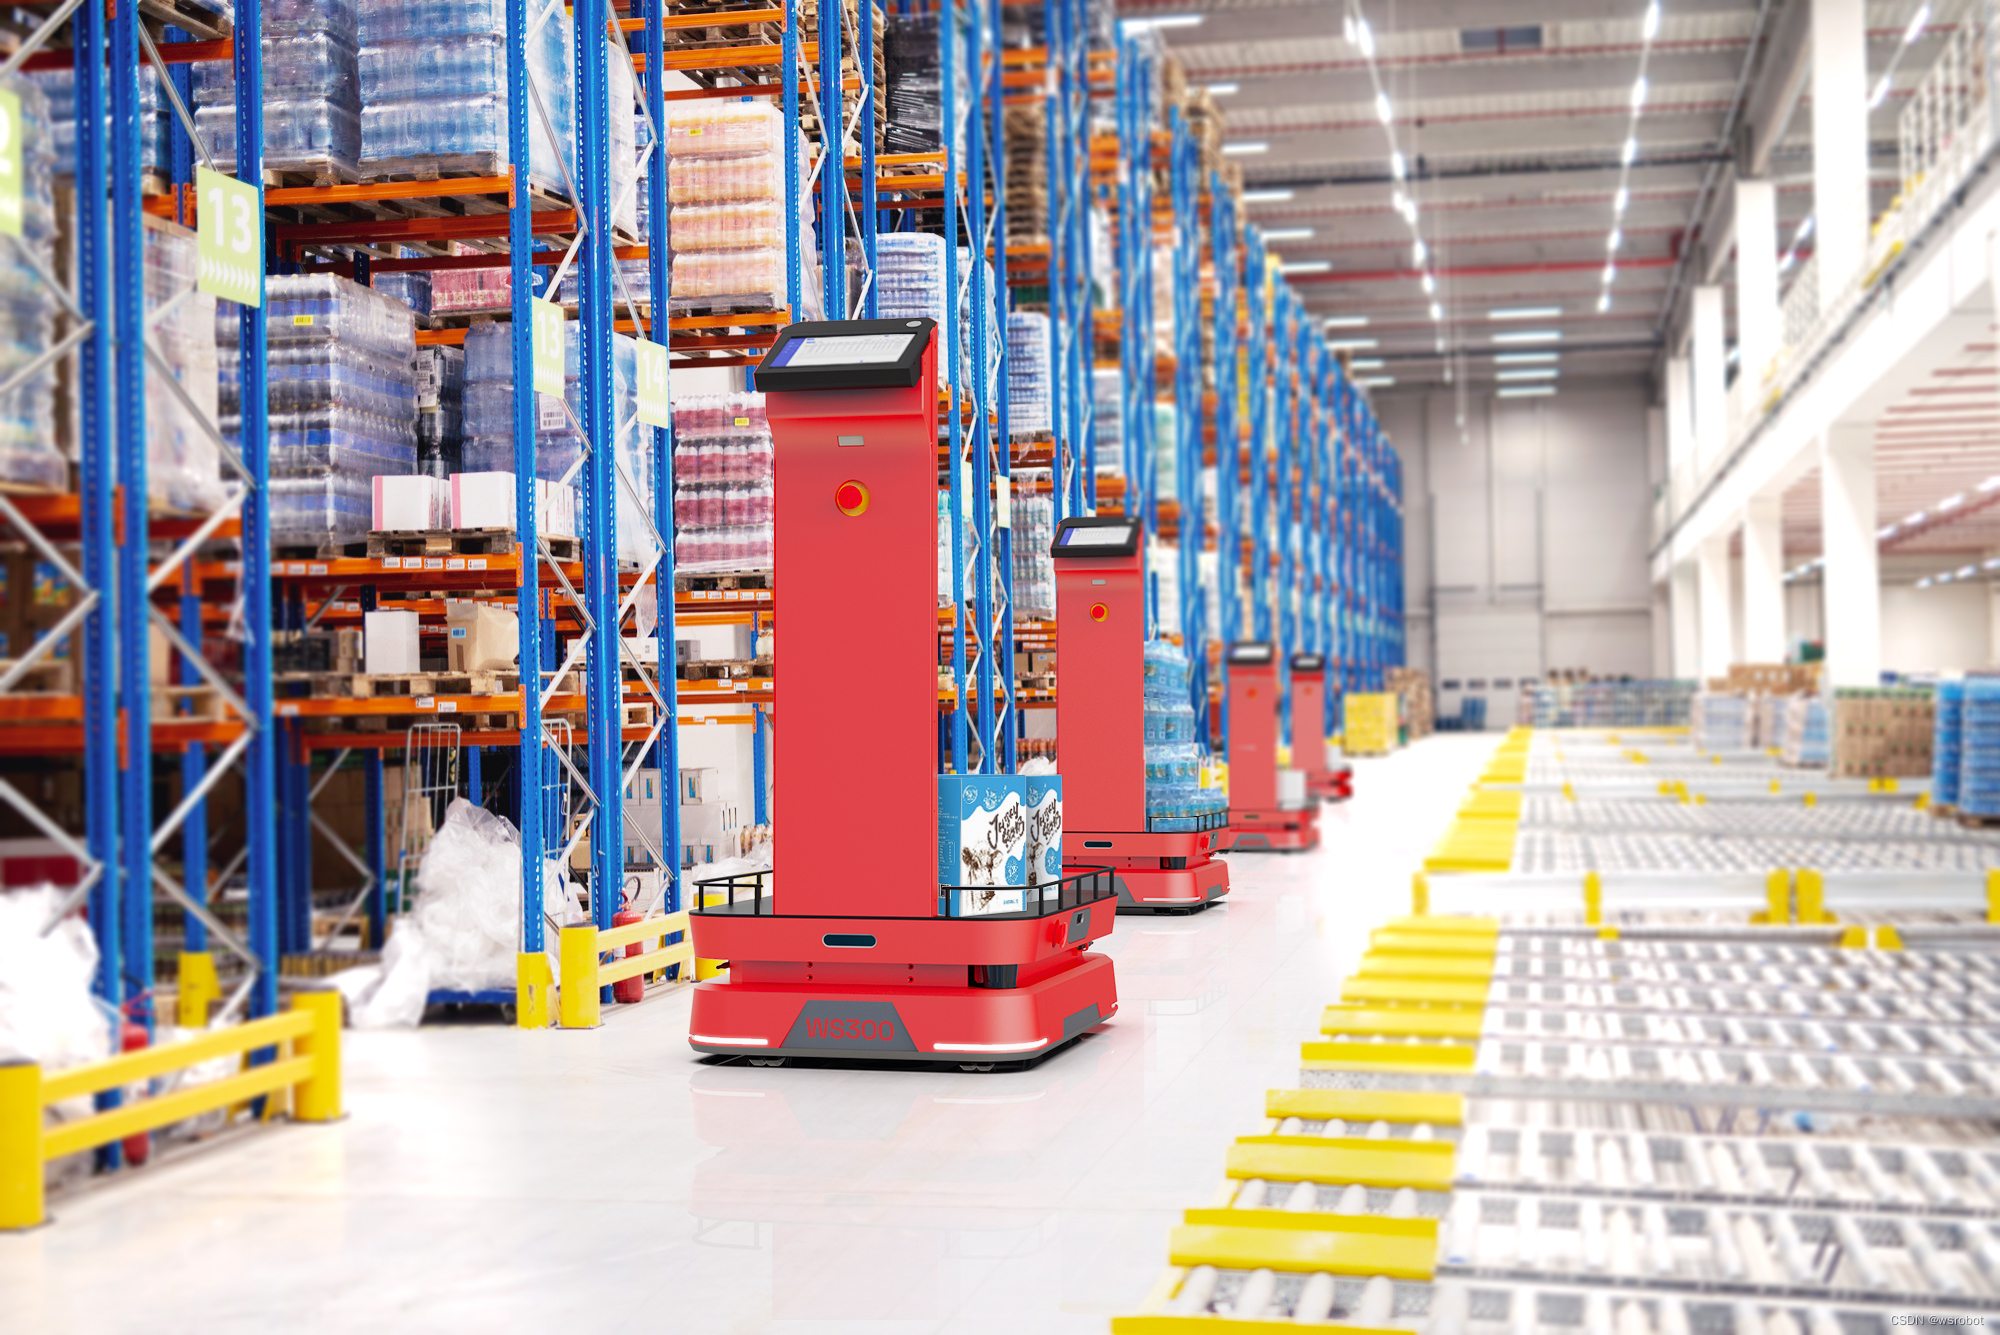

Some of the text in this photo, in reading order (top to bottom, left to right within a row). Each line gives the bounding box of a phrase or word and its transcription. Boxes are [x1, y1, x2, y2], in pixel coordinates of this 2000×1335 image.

[208, 187, 252, 254] 13
[537, 310, 560, 359] 13
[642, 350, 665, 393] 14
[806, 1018, 894, 1041] WS300
